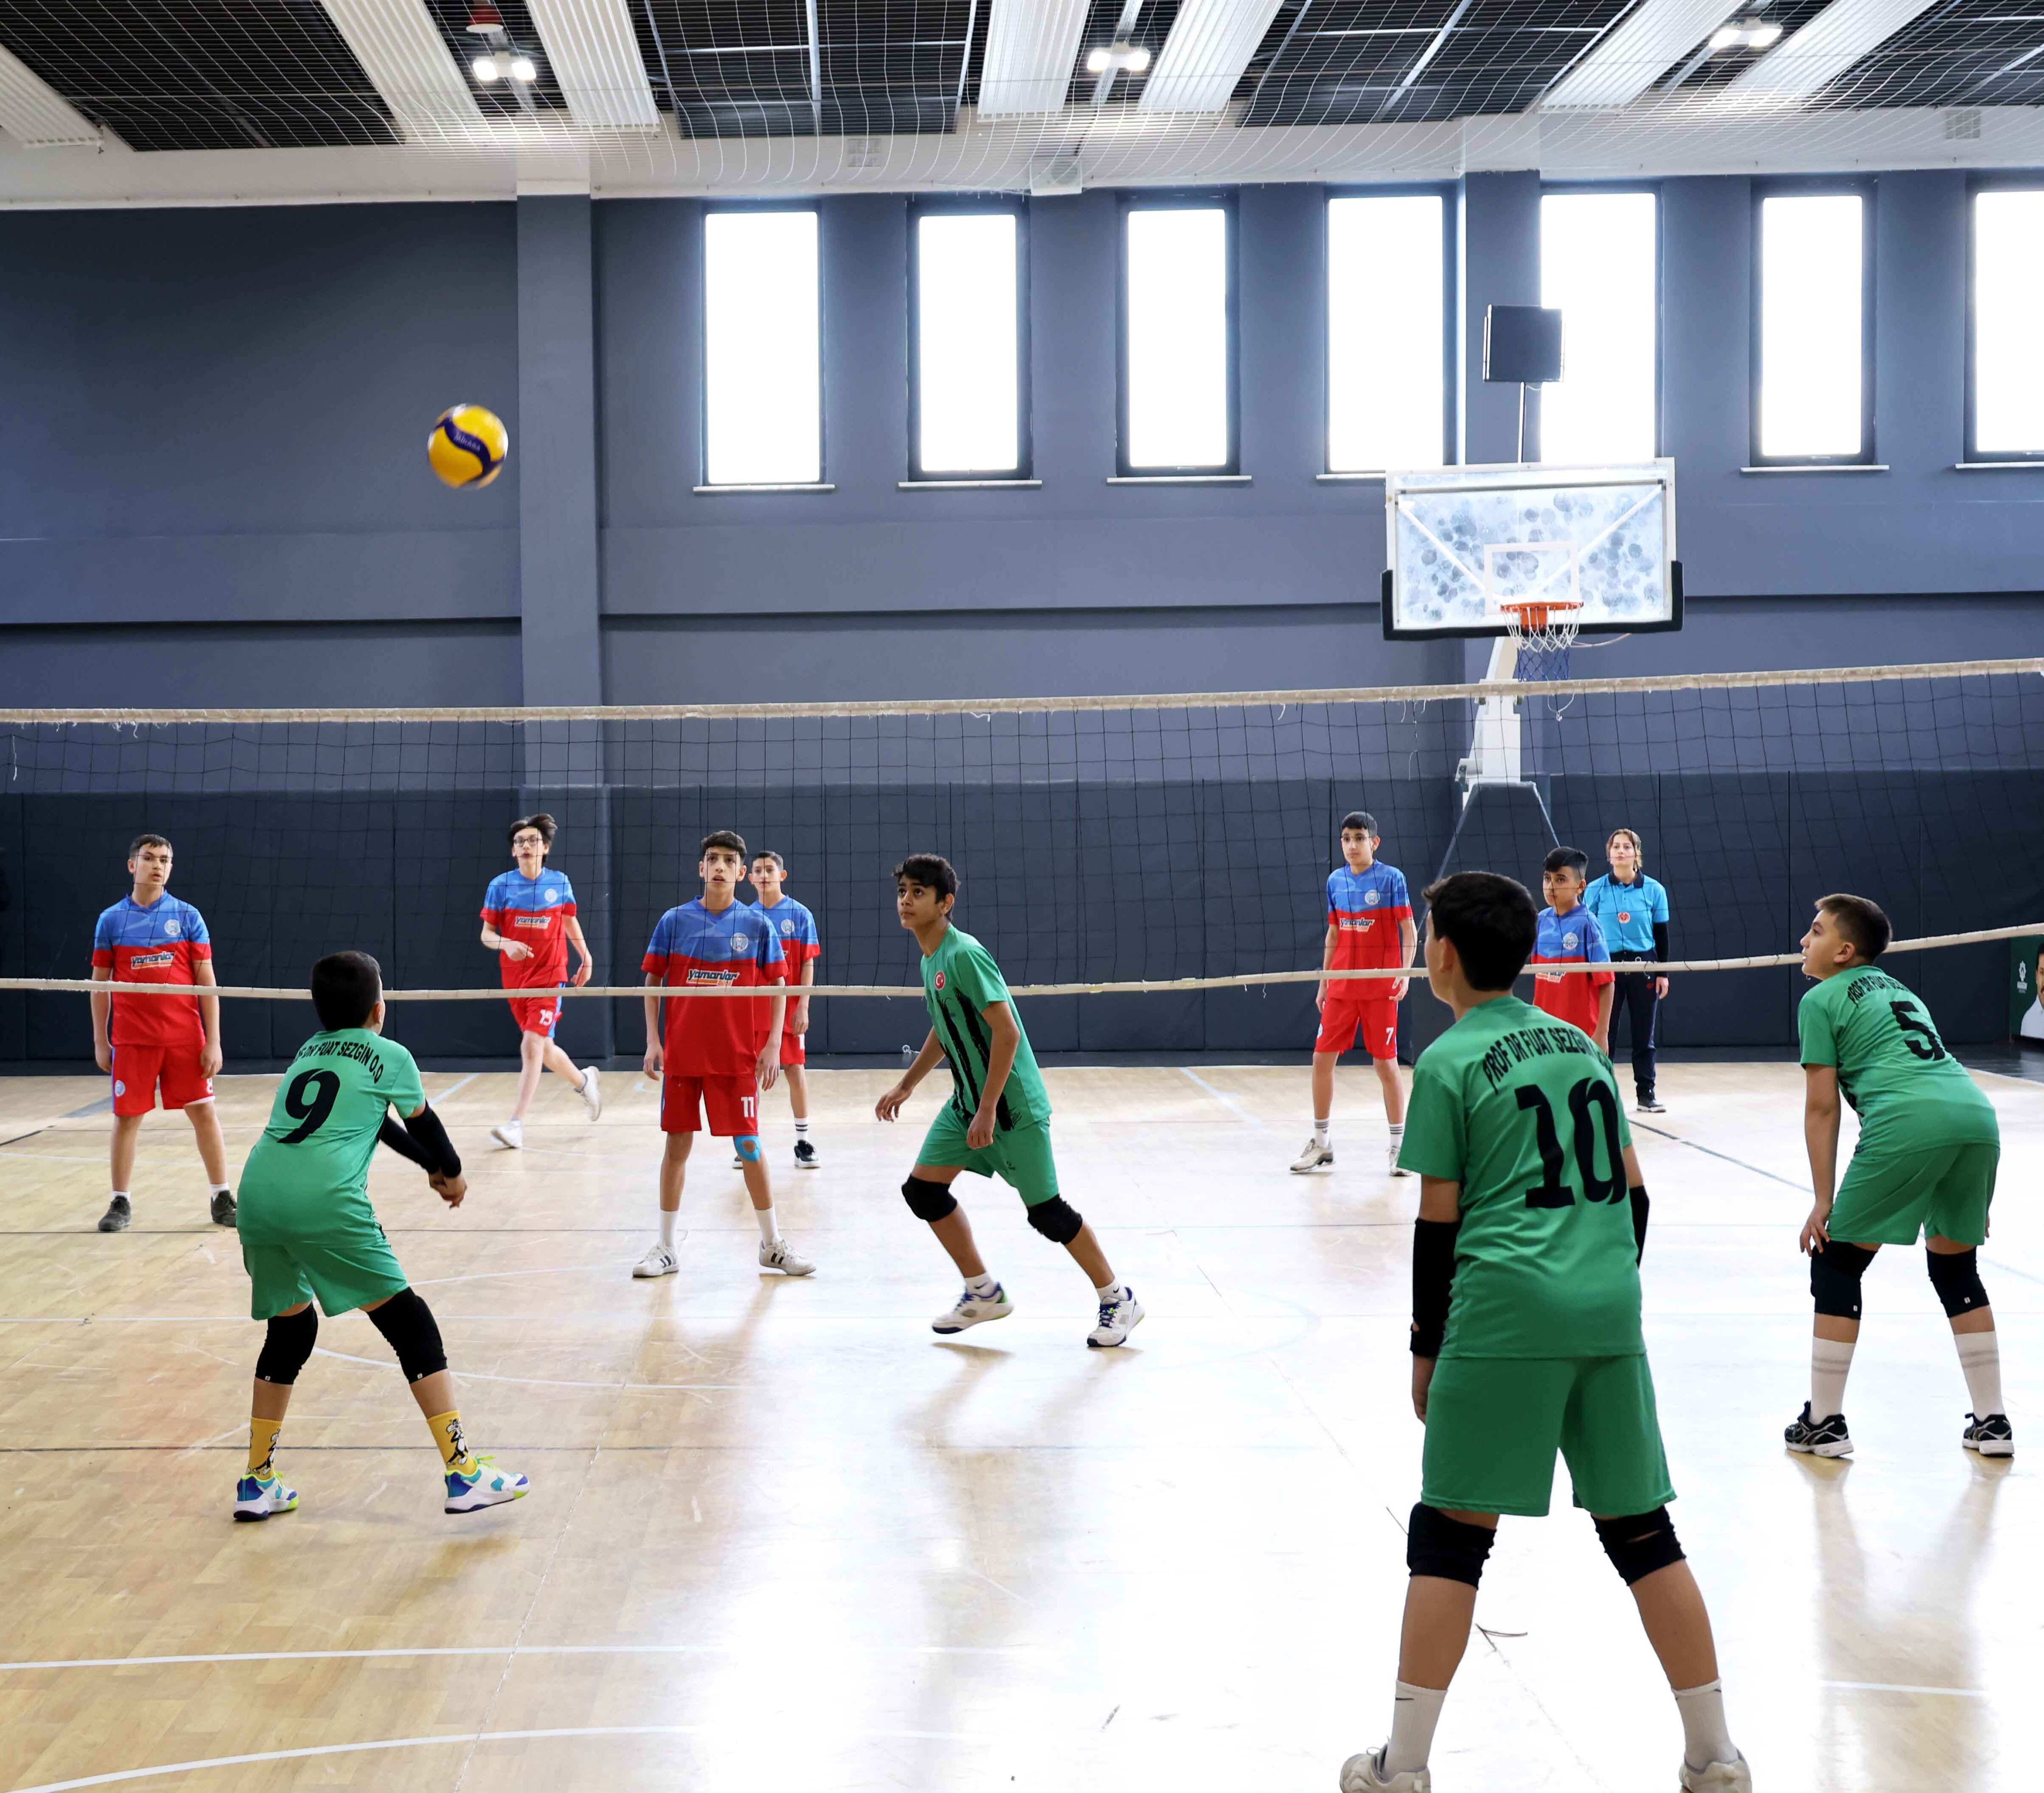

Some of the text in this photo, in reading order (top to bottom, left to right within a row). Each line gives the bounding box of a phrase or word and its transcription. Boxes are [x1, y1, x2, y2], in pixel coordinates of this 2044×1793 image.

[688, 970, 739, 981] yamanlar
[539, 1009, 553, 1026] 15
[1386, 1027, 1394, 1045] 7
[1889, 1001, 1945, 1061] 5
[337, 1041, 374, 1066] SEZGİN
[1483, 1040, 1513, 1095] PROF
[1503, 1032, 1529, 1063] DR
[1518, 1027, 1555, 1058] FUAT
[277, 1068, 340, 1144] 9
[741, 1096, 755, 1117] 11
[1514, 1077, 1627, 1208] 10
